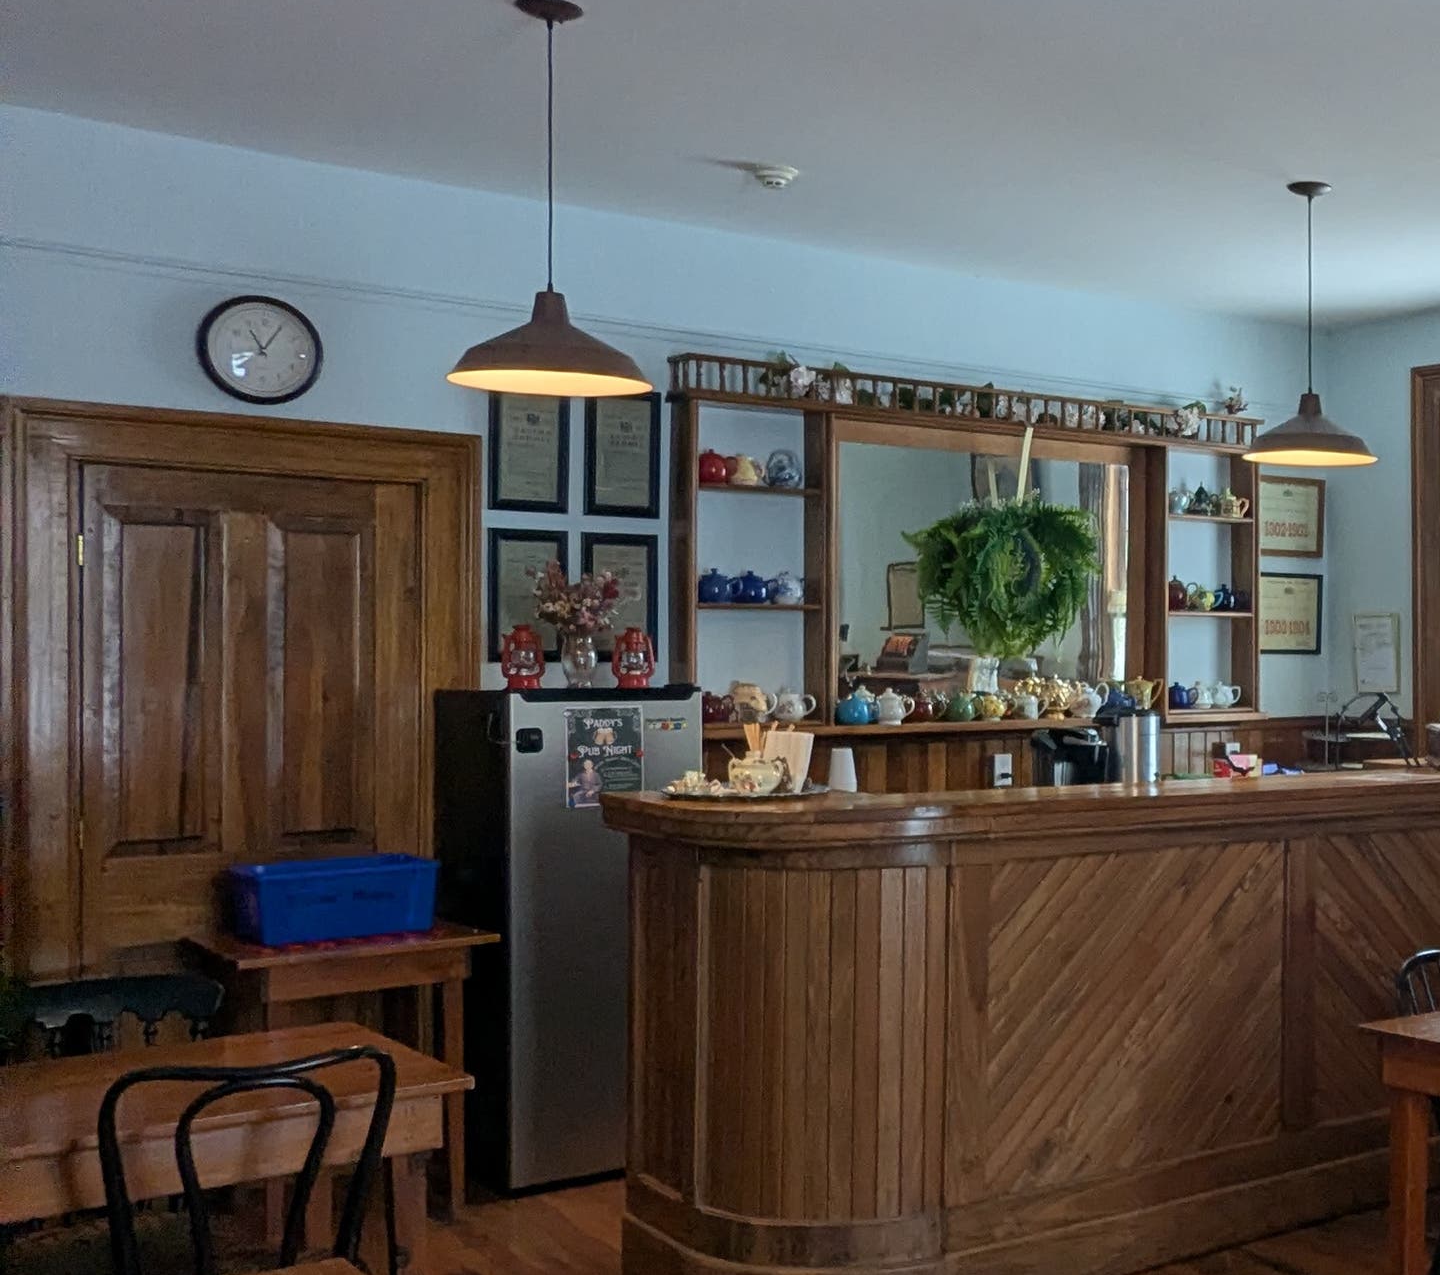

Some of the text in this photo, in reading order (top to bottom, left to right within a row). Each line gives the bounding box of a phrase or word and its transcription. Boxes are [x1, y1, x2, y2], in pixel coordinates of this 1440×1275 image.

[583, 718, 623, 729] PADDY'S
[577, 745, 633, 757] PUB NIGHT
